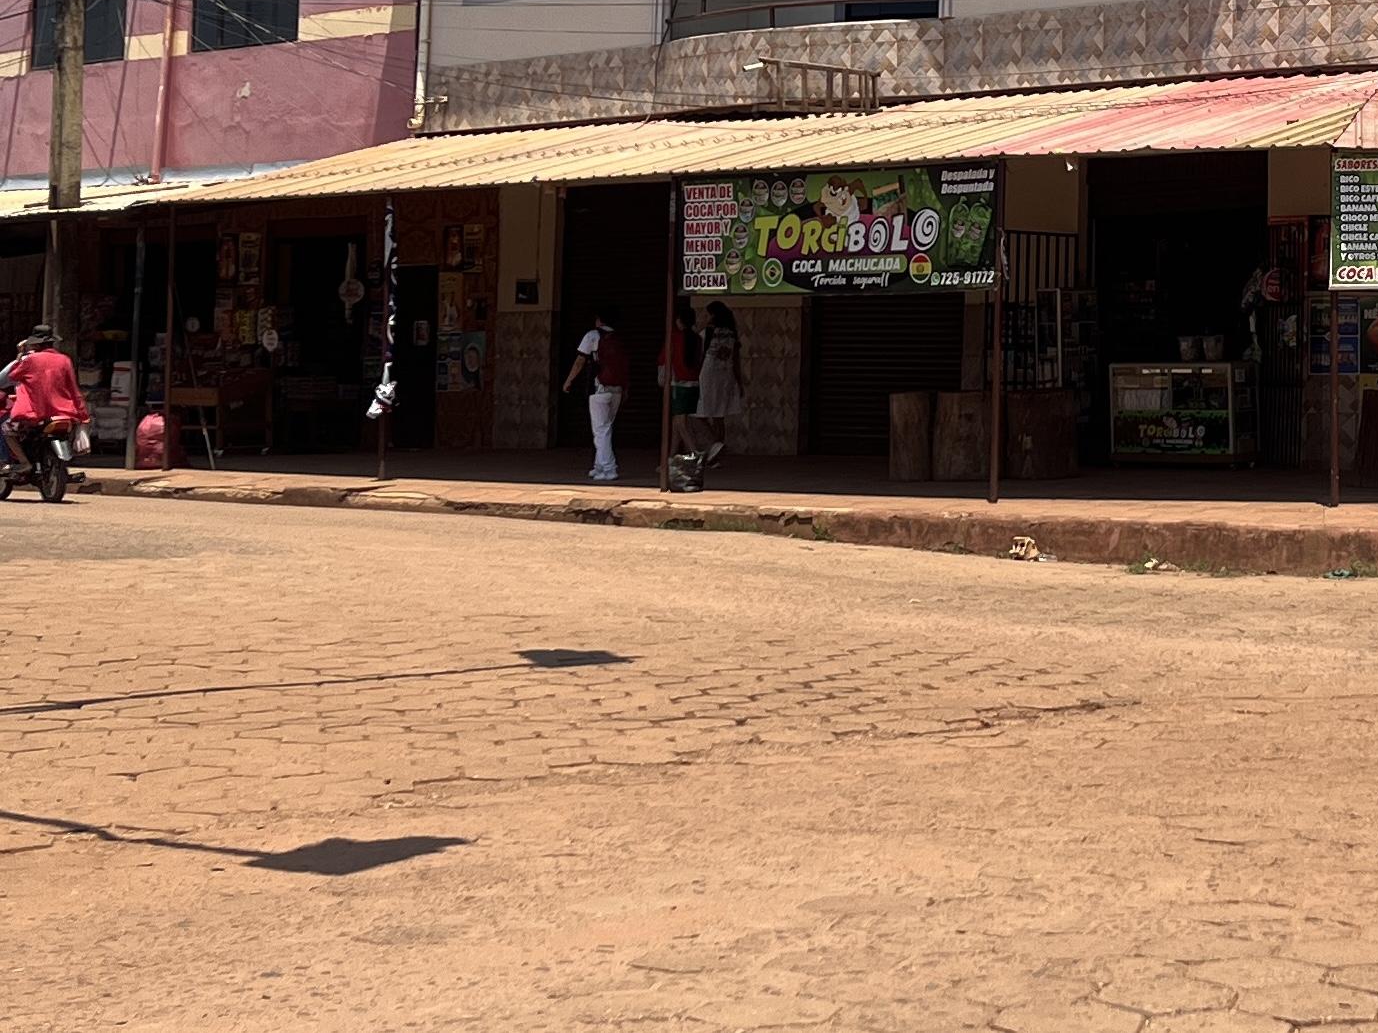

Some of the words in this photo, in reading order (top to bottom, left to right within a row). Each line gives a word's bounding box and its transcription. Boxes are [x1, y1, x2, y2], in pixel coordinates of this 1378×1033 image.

[685, 185, 717, 200] VENTA
[718, 184, 733, 199] DE
[685, 203, 714, 218] COCA
[715, 202, 737, 217] POR
[1340, 204, 1378, 212] BANANA
[1340, 214, 1369, 222] CHOCO
[685, 221, 721, 236] MAYOR
[722, 220, 730, 235] Y
[685, 238, 722, 254] MENOR
[1340, 243, 1377, 251] BANANA
[685, 256, 693, 271] Y
[693, 256, 715, 271] POR
[1340, 253, 1347, 261] Y
[1347, 252, 1376, 260] OTROS
[792, 260, 822, 273] COCA
[828, 257, 901, 272] MACHUCADA
[811, 273, 846, 287] Torcida
[940, 271, 995, 285] 725-91772
[1338, 266, 1374, 280] COCA
[684, 273, 727, 289] DOCENA
